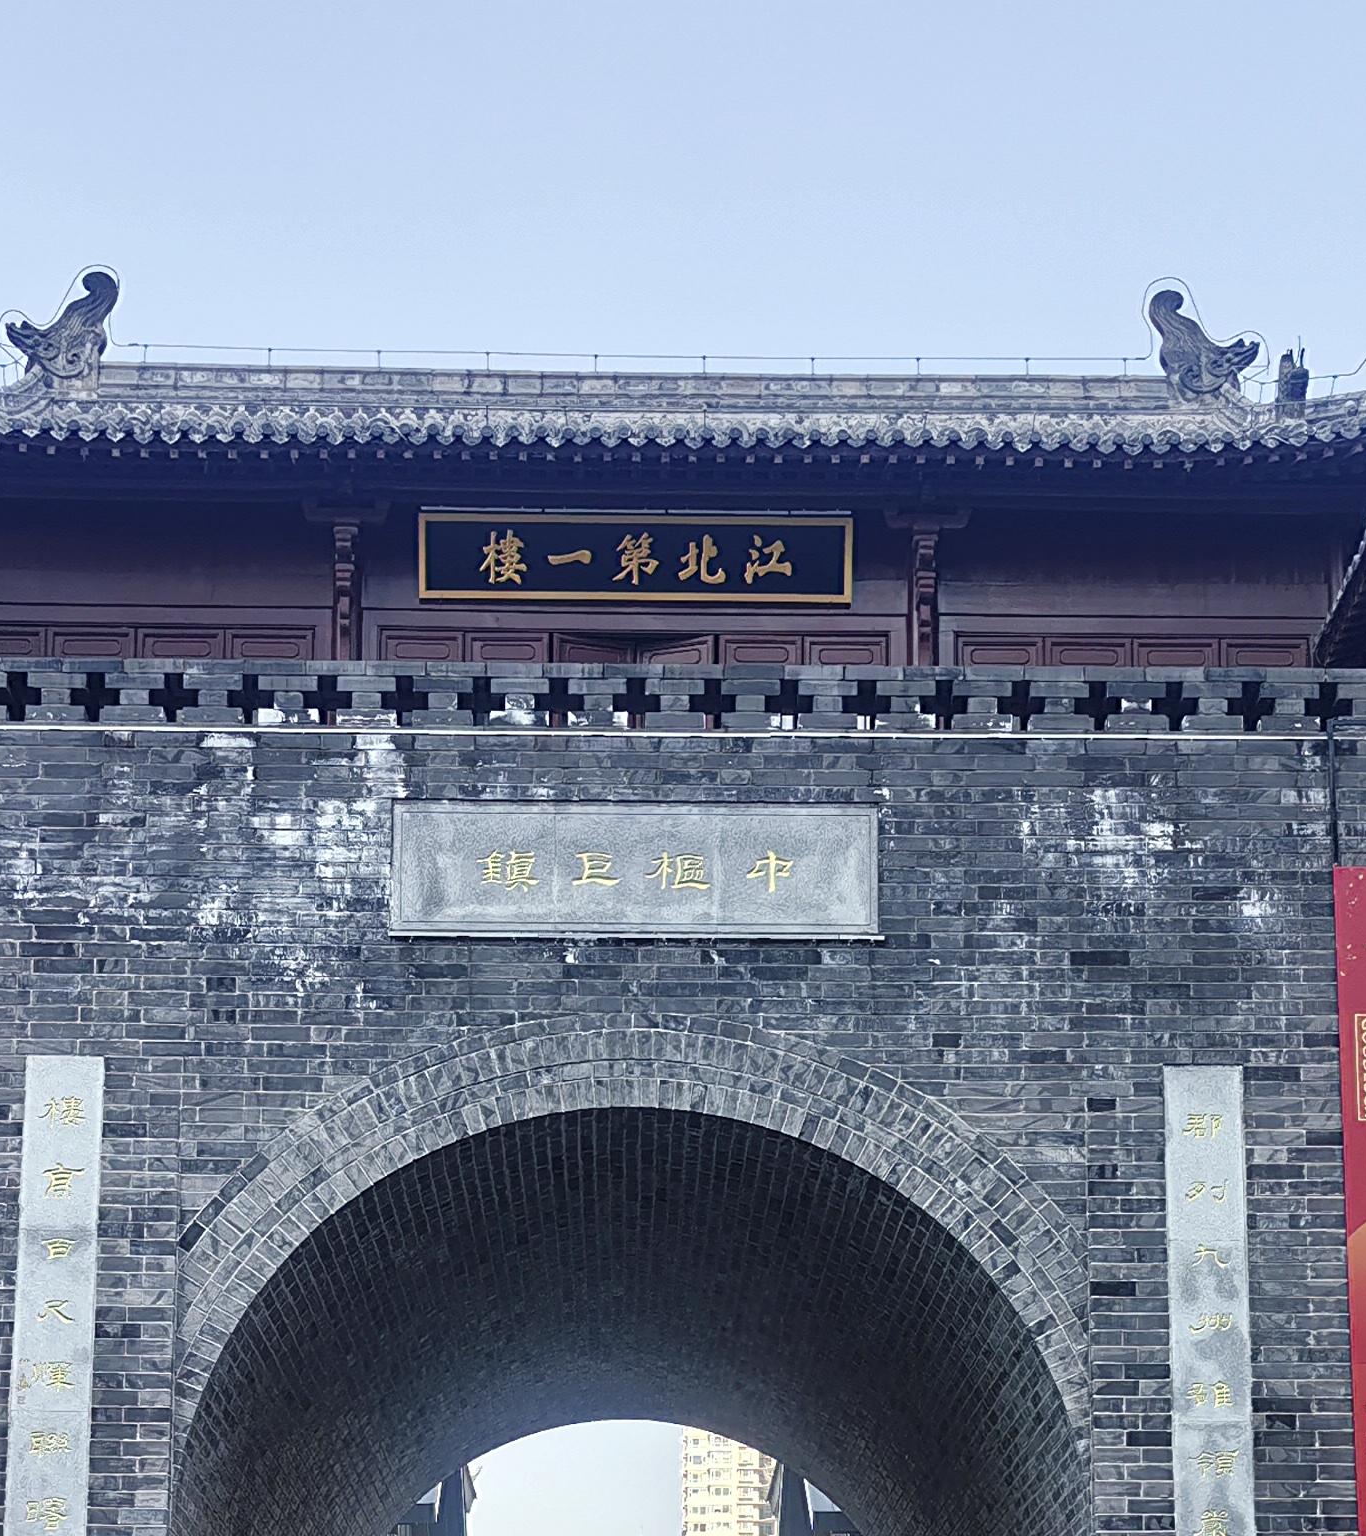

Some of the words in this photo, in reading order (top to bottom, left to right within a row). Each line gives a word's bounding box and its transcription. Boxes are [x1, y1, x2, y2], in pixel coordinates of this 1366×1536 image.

[479, 528, 793, 585] 江北第一樓
[476, 848, 795, 893] 中樞巨鎮
